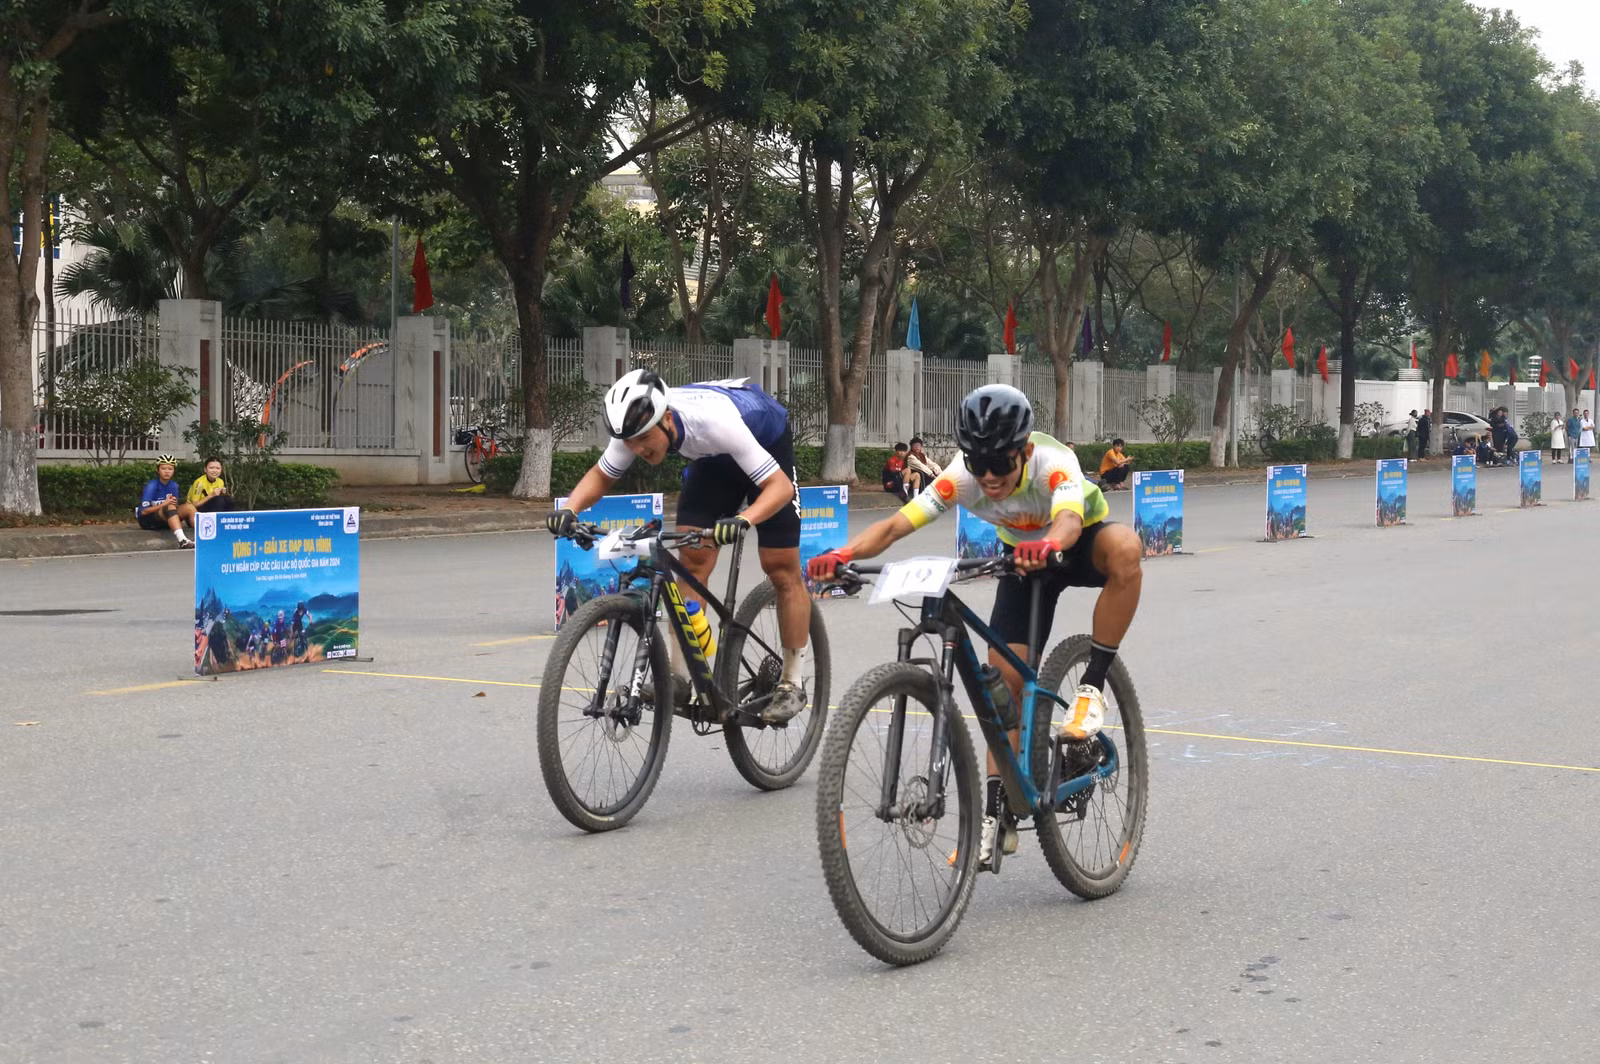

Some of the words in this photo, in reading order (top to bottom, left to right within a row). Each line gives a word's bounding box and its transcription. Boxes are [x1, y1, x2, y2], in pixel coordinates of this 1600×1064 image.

[233, 539, 252, 558] VÒNG
[253, 541, 257, 556] 1
[264, 536, 278, 554] GIẢI
[279, 539, 288, 553] XE
[289, 539, 303, 556] ĐẠP
[303, 538, 315, 556] ĐỊA
[315, 535, 332, 553] HÌNH
[229, 563, 236, 573] LY
[260, 559, 271, 571] CÁC
[281, 559, 290, 571] LẠC
[290, 558, 297, 570] BỘ
[298, 557, 311, 570] QUỐC
